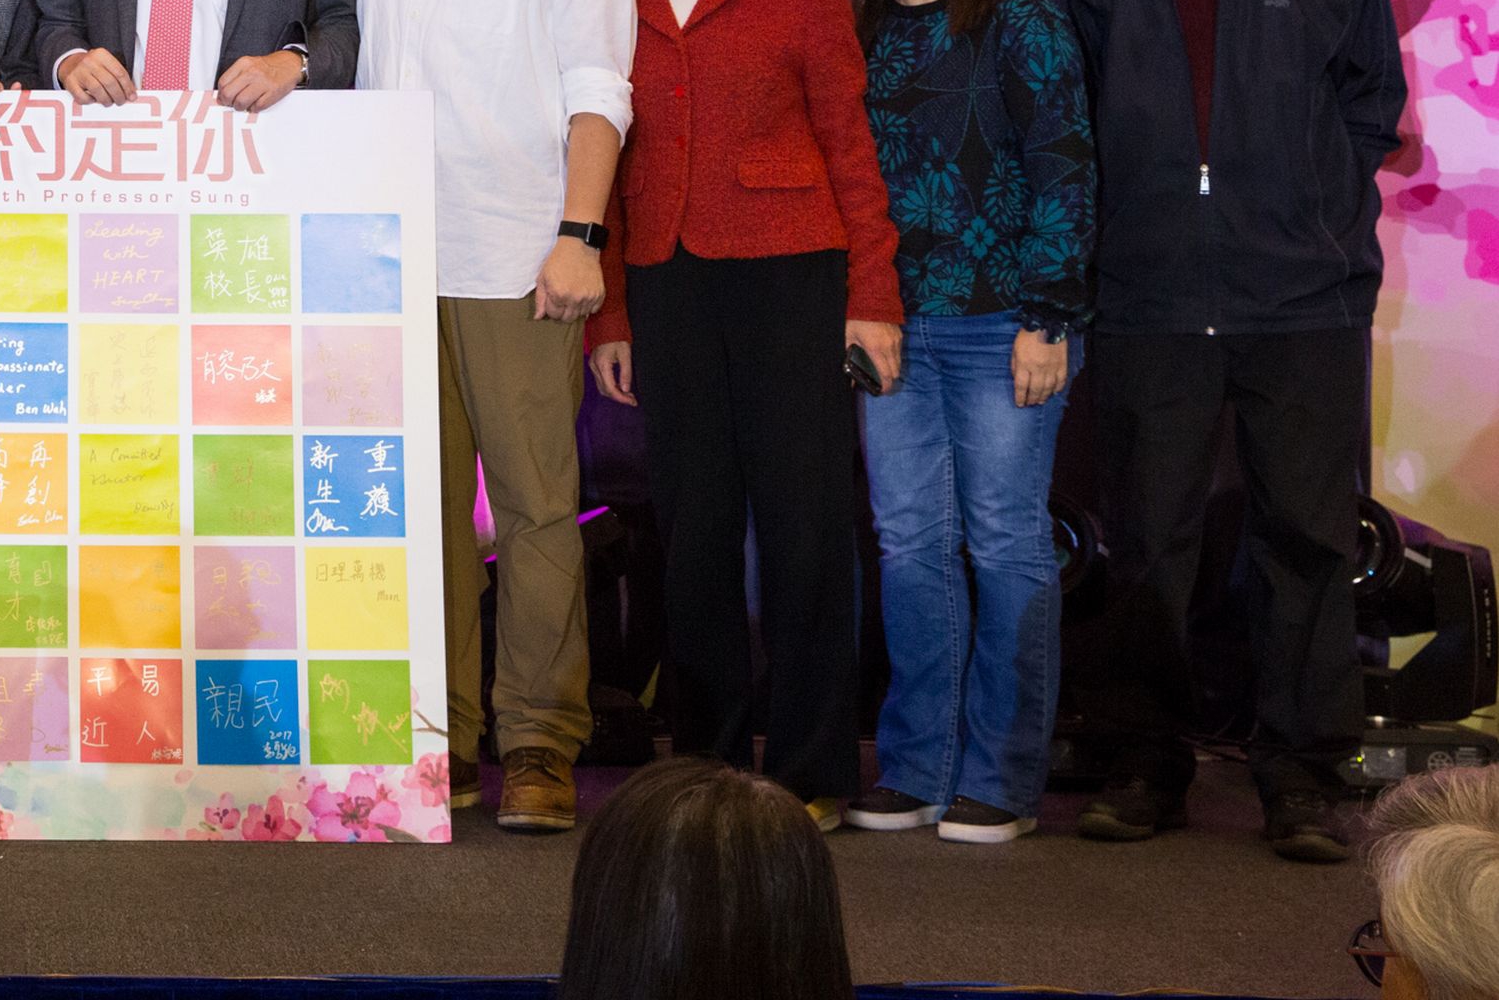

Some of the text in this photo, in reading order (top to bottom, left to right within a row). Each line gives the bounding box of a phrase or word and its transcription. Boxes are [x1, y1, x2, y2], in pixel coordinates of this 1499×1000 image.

[43, 189, 174, 204] Professor
[190, 189, 250, 208] Sung
[92, 267, 166, 290] HEART
[195, 348, 282, 385] 有容乃大
[15, 401, 39, 415] Ben
[202, 676, 284, 729] 親民
